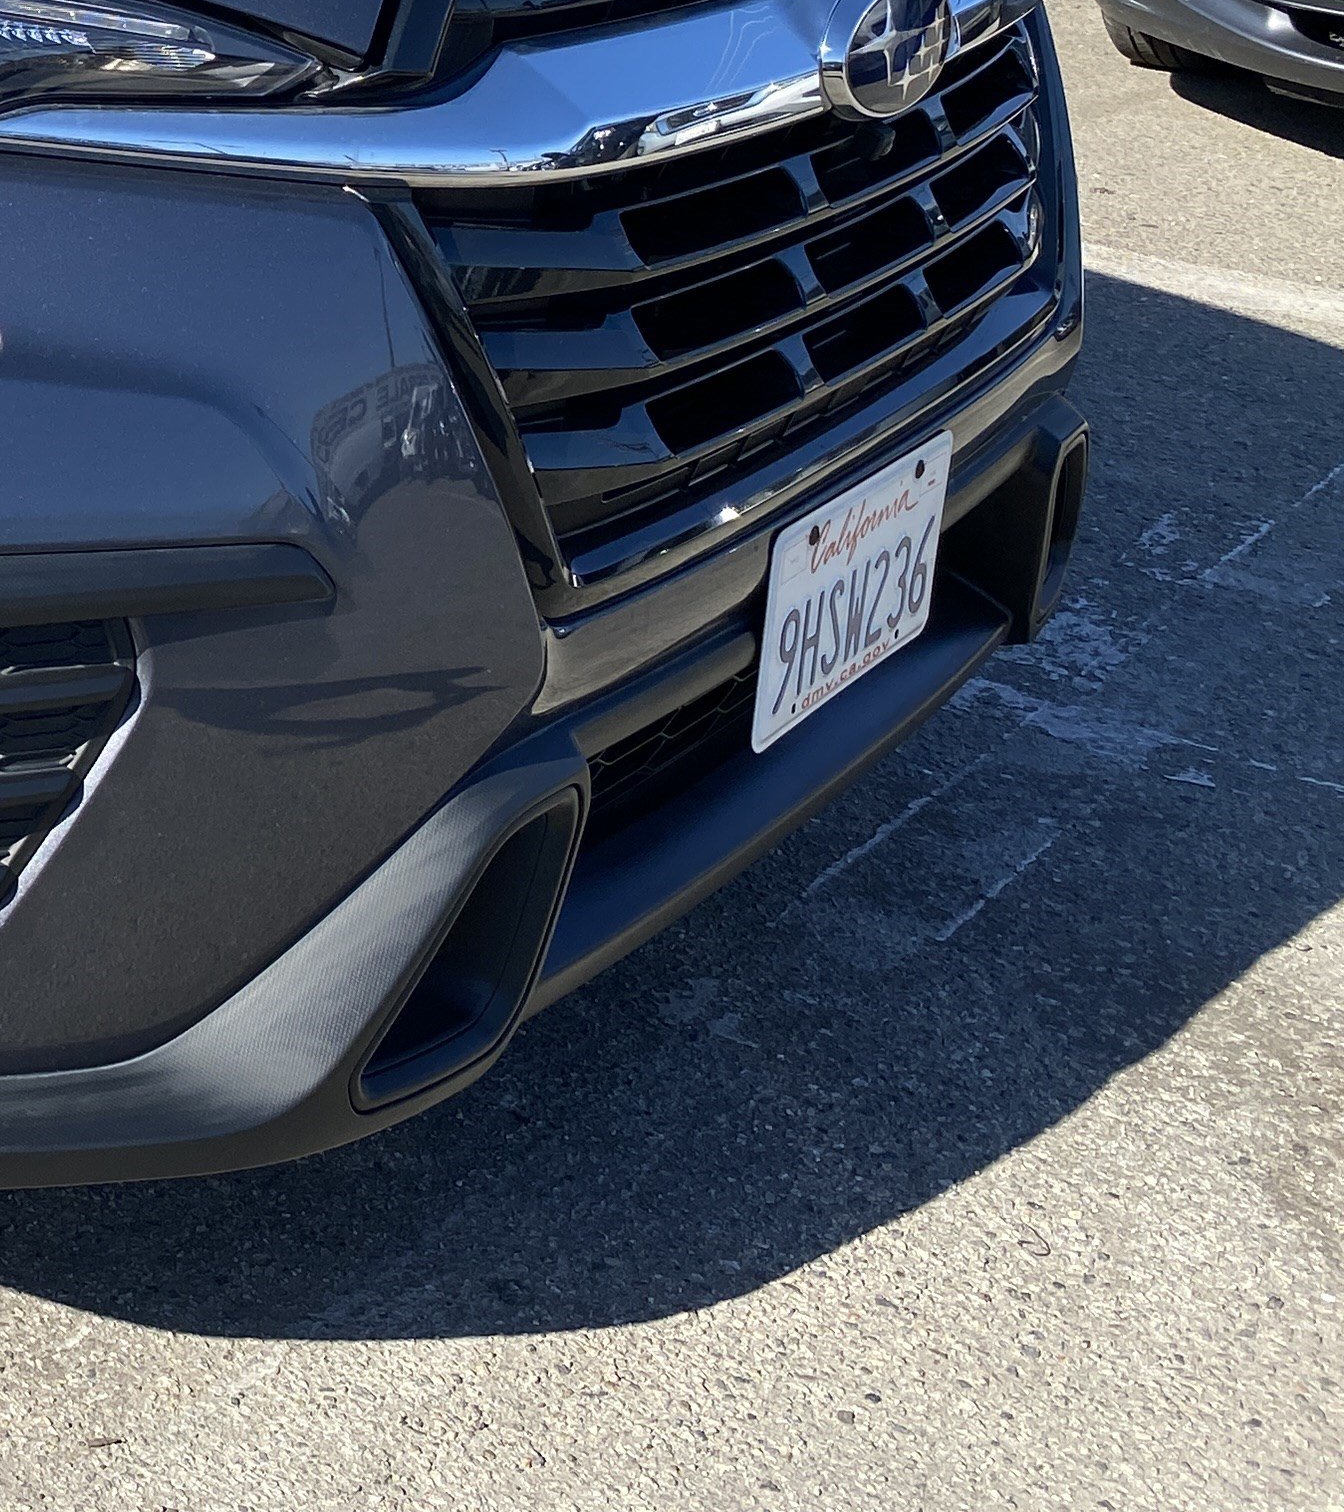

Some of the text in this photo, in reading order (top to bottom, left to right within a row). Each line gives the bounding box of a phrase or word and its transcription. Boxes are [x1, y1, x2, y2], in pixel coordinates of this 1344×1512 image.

[808, 480, 919, 574] California
[772, 514, 935, 715] 9HSW236
[801, 638, 891, 710] dmv.ca.gov
